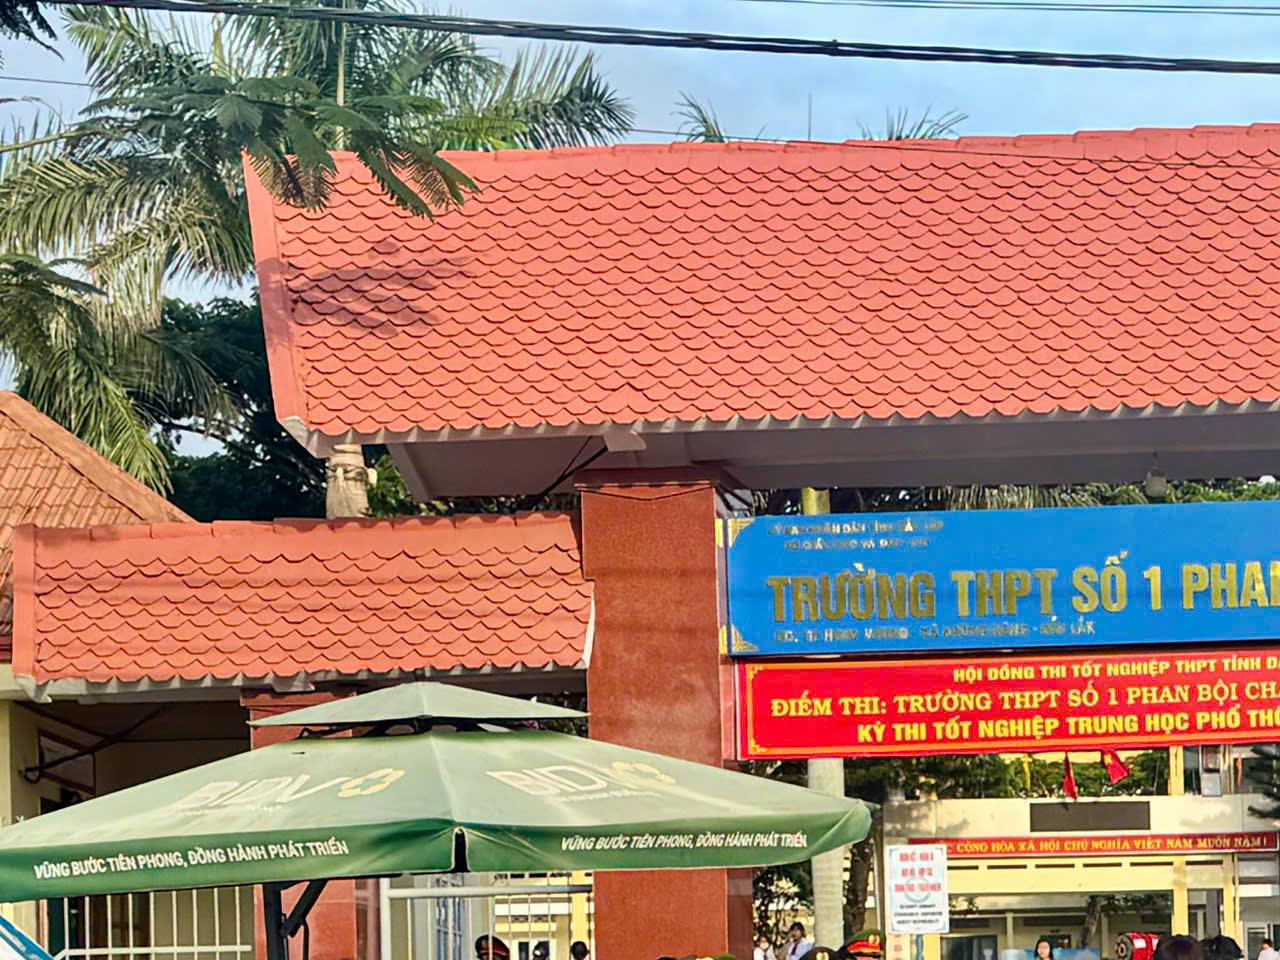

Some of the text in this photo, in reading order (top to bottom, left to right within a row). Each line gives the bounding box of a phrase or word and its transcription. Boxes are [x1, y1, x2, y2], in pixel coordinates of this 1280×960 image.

[767, 562, 936, 623] TRƯỜNG
[951, 569, 1058, 617] THPT
[1071, 549, 1128, 613] SỐ
[1143, 565, 1162, 611] 1
[953, 666, 982, 684] HỘI
[1040, 665, 1067, 679] THI
[1072, 661, 1102, 678] TỐT
[1106, 657, 1170, 677] NGHIỆP
[1175, 659, 1217, 673] THPT
[1222, 654, 1261, 671] TỈNH
[771, 689, 832, 717] ĐIỂM
[838, 696, 887, 716] THI:
[893, 688, 993, 714] TRƯỜNG
[998, 690, 1061, 710] THPT
[1068, 679, 1099, 707] SỐ
[1107, 687, 1119, 705] 1
[1126, 686, 1195, 705] PHAN
[1196, 679, 1238, 706] BỘI
[892, 722, 927, 741] THI
[932, 715, 972, 740] TỐT
[978, 715, 1059, 740] NGHIỆP
[1065, 714, 1139, 735] TRUNG
[1145, 712, 1189, 735] HỌC
[1196, 703, 1241, 729] PHỔ
[71, 855, 107, 876] BƯỚC
[105, 852, 137, 872] TIÊN
[136, 851, 188, 869] PHONG,
[188, 846, 226, 865] ĐỒNG
[226, 843, 268, 862] HÀNH
[267, 839, 305, 859] PHÁT
[305, 835, 349, 856] TRIỂN
[631, 833, 656, 849] TIÊN
[655, 834, 694, 849] PHONG,
[695, 831, 726, 848] ĐỒNG
[725, 831, 753, 848] HÀNH
[753, 831, 780, 848] PHÁT
[1166, 837, 1193, 849] NAM
